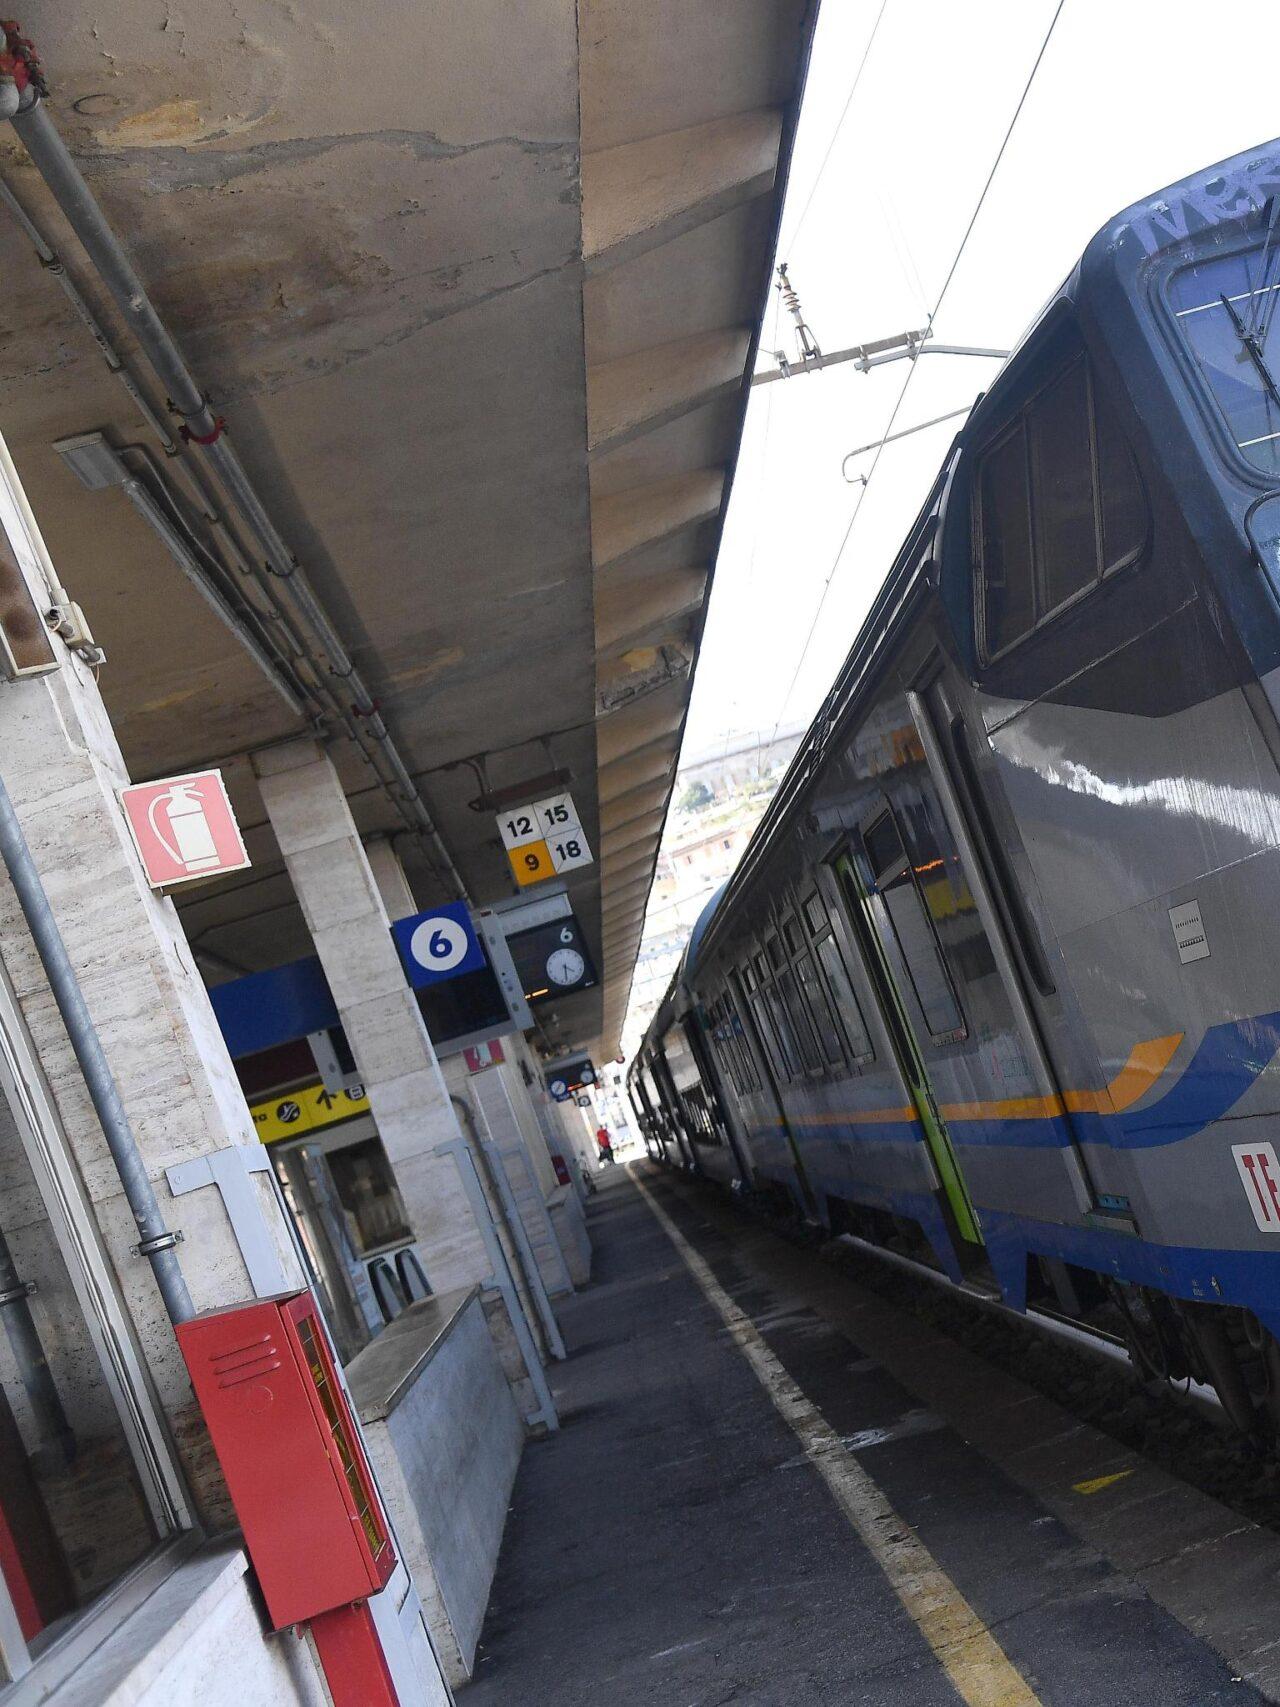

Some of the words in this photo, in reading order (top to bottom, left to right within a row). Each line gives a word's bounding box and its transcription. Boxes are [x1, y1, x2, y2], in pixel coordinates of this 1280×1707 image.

[507, 816, 533, 838] 12
[544, 804, 569, 825] 15
[524, 854, 539, 871] 9
[556, 840, 581, 860] 18
[429, 929, 453, 958] 6
[560, 927, 573, 943] 6
